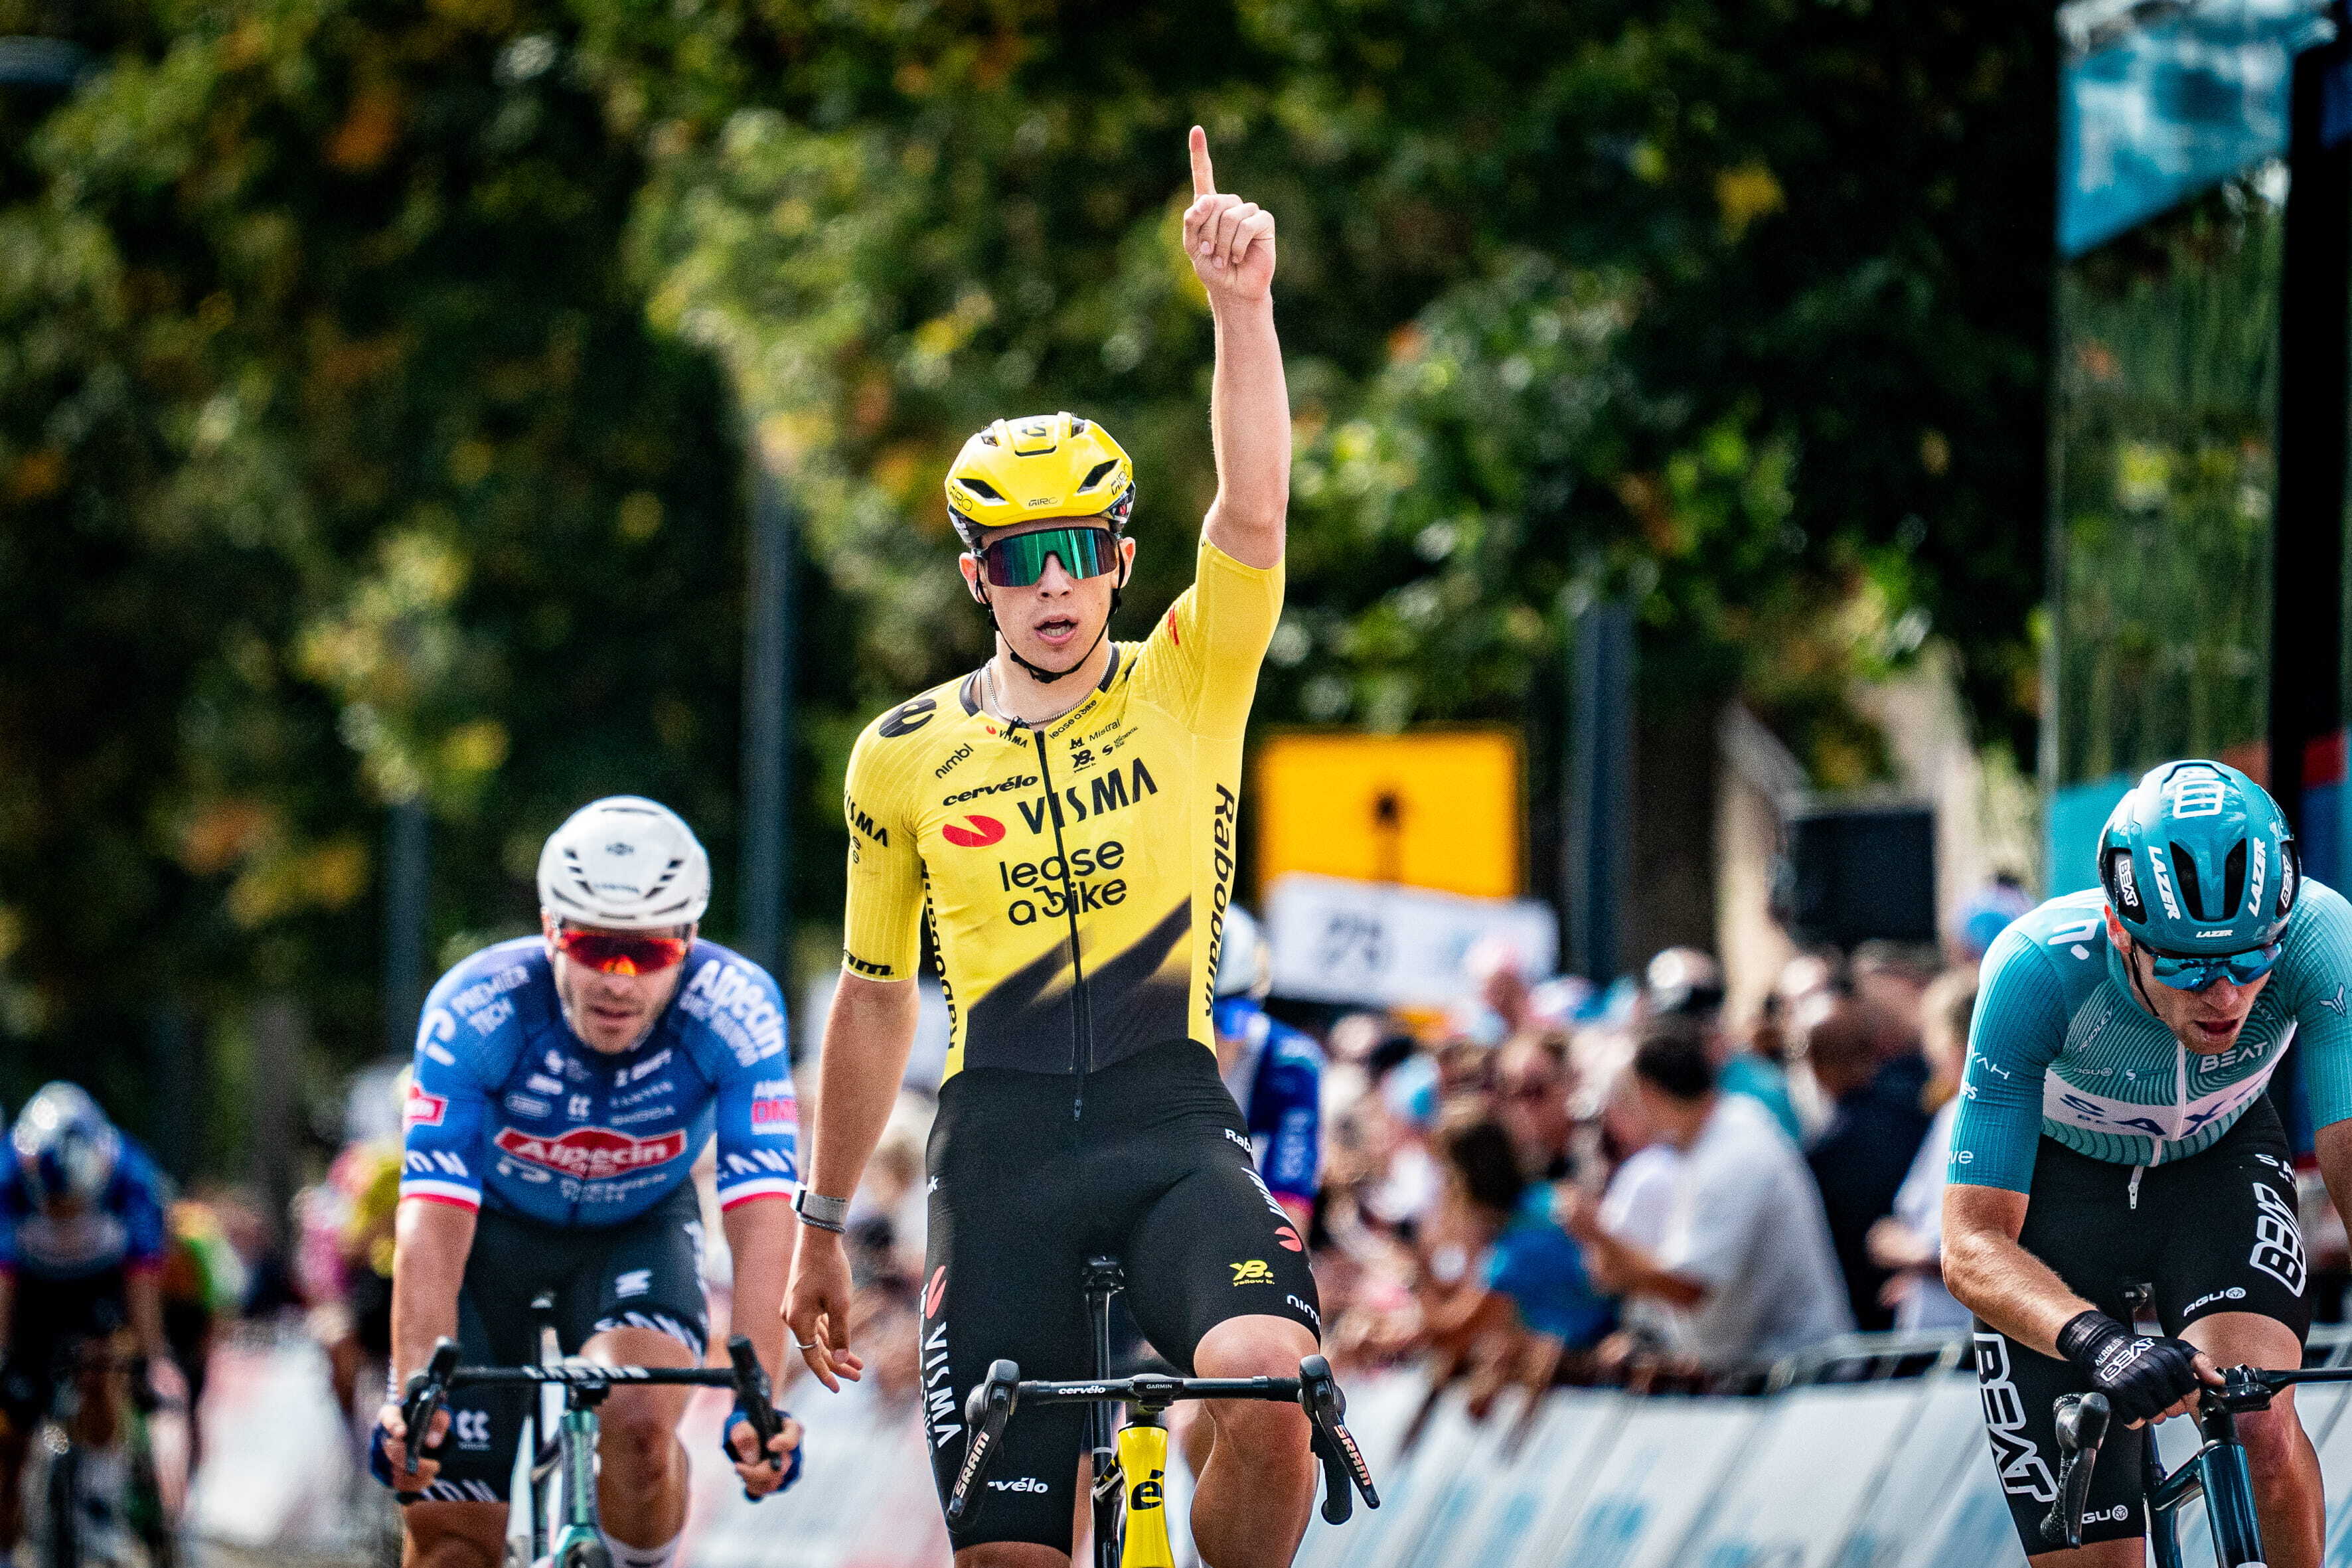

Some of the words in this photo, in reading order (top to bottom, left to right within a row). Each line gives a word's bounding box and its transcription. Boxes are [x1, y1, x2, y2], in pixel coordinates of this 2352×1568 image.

[1028, 497, 1058, 507] GIRO
[1089, 718, 1121, 742] Mistral
[935, 743, 975, 779] nimbl
[943, 774, 1038, 807] cervélo
[1016, 757, 1158, 835] VISMA
[999, 840, 1125, 892] lease
[2148, 845, 2181, 920] LAZER
[2248, 837, 2266, 917] LAZER
[2196, 929, 2233, 938] LAZER
[2199, 1042, 2268, 1073] BEAT
[2059, 1063, 2276, 1138] SAX
[513, 1140, 667, 1166] Alpecin
[1233, 1279, 1264, 1287] yellow
[1287, 1294, 1320, 1326] nim
[2183, 1291, 2225, 1317] AGU
[2100, 1337, 2156, 1382] BEAT
[925, 1321, 962, 1448] VISMA
[1058, 1385, 1106, 1395] cervélo
[1974, 1332, 2060, 1502] BEAT
[955, 1431, 990, 1498] SRAM
[1333, 1425, 1372, 1486] SRAM
[987, 1477, 1049, 1494] rvélo
[2082, 1508, 2110, 1524] GU
